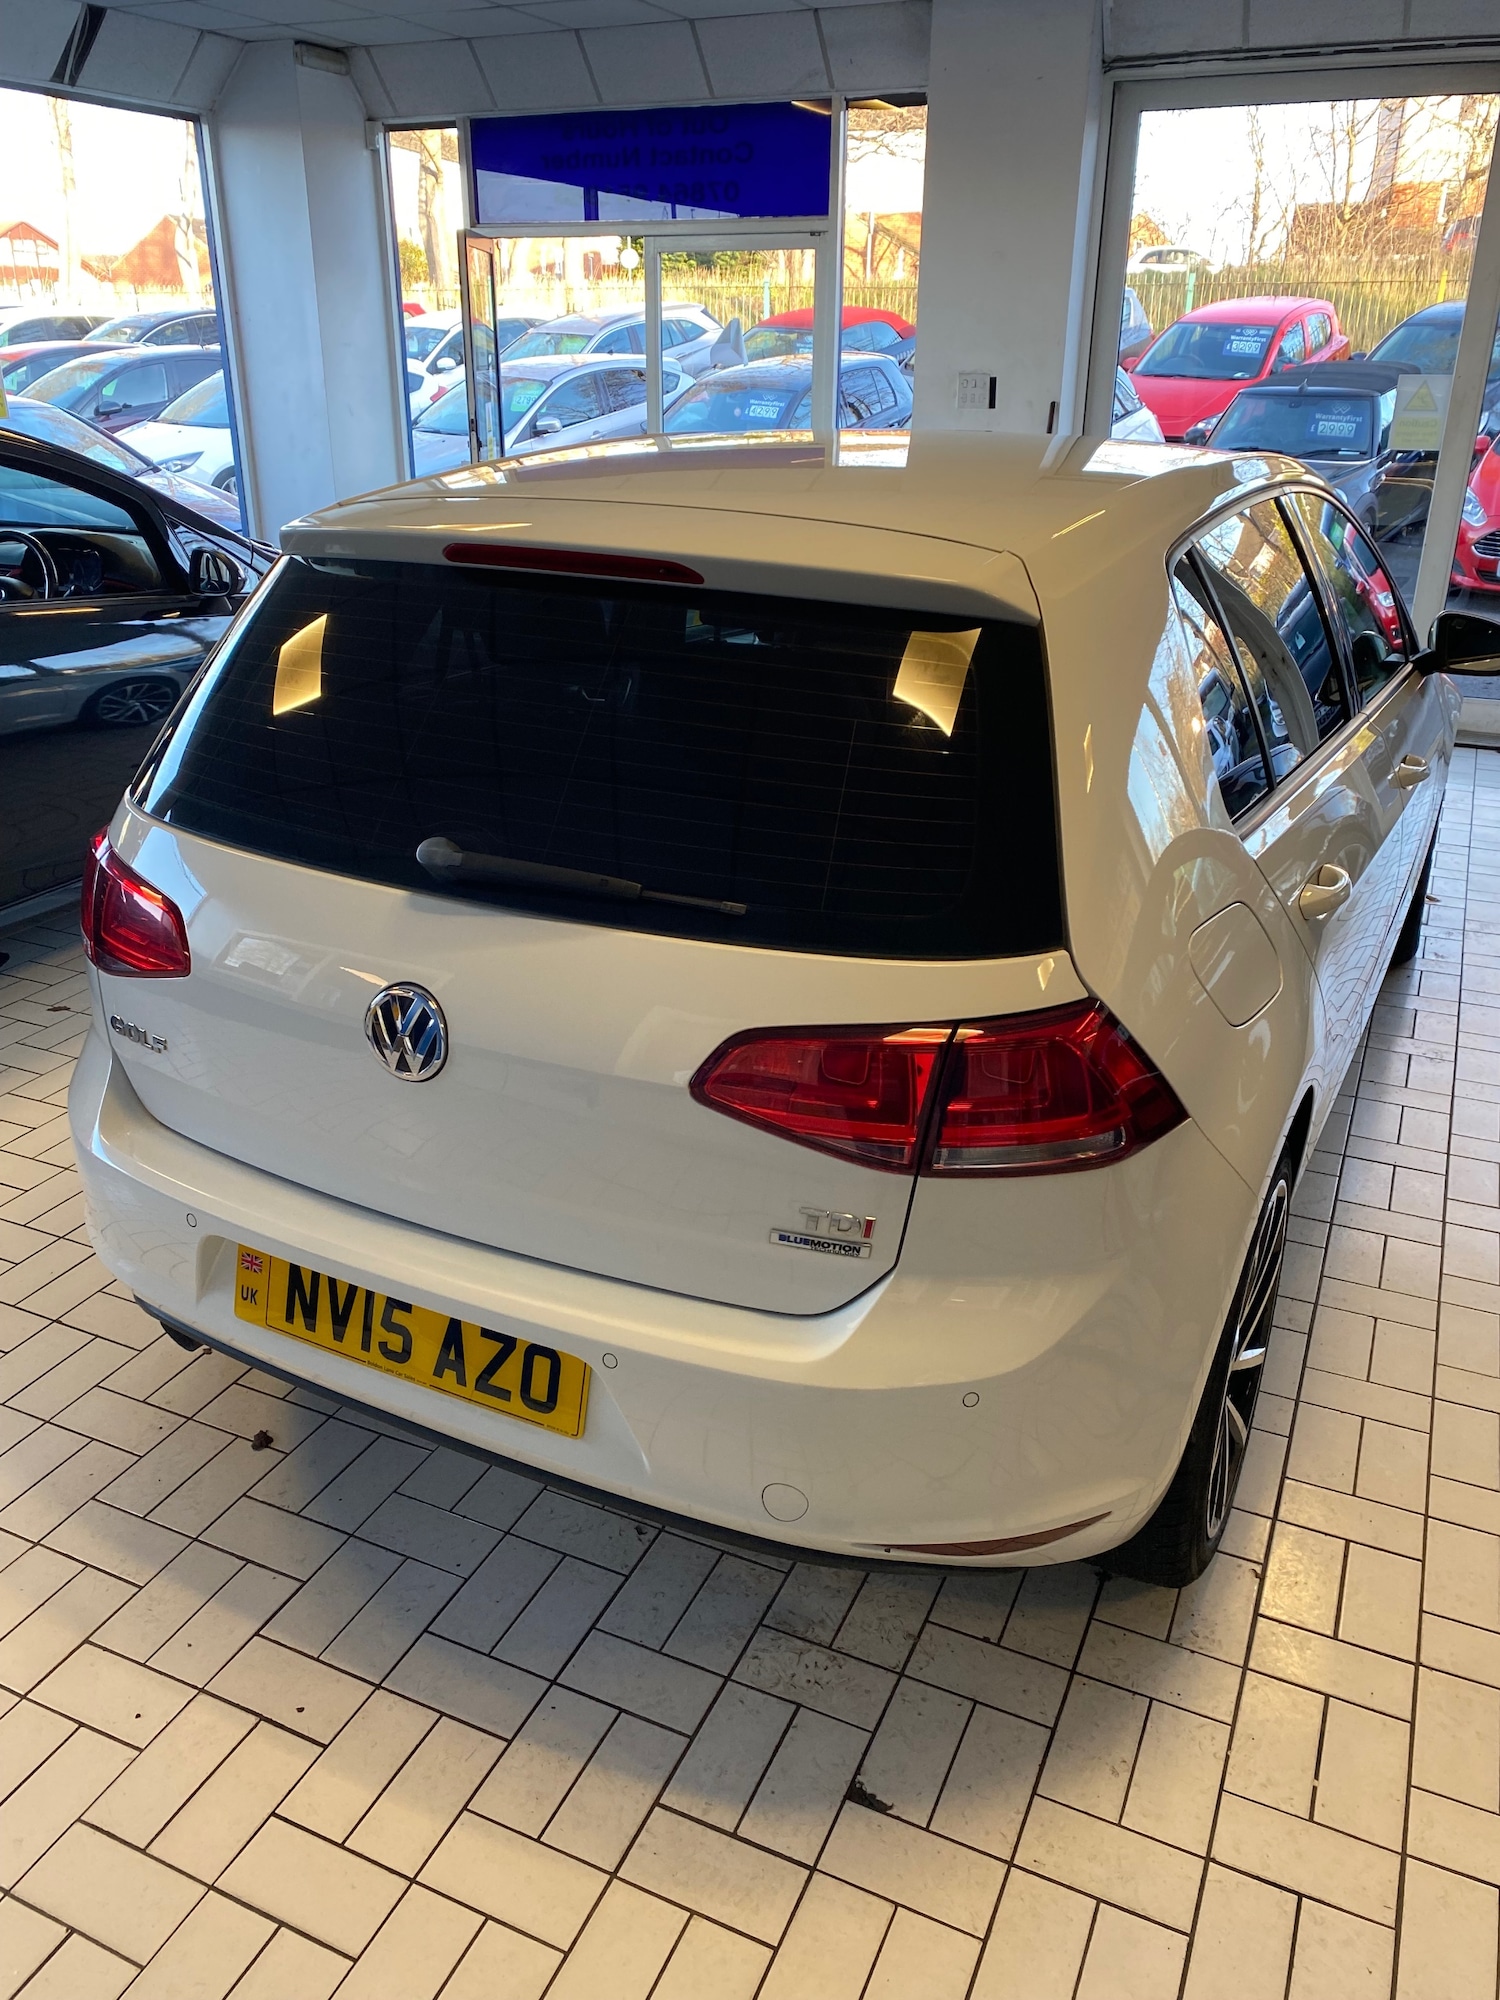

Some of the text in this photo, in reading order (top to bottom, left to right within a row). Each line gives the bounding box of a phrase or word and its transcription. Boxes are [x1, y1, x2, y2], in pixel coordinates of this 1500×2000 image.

[110, 1014, 168, 1054] GOLF
[799, 1206, 877, 1239] TDI
[778, 1233, 861, 1254] BLUEMOTION
[241, 1284, 258, 1305] UK
[285, 1262, 413, 1364] NV15
